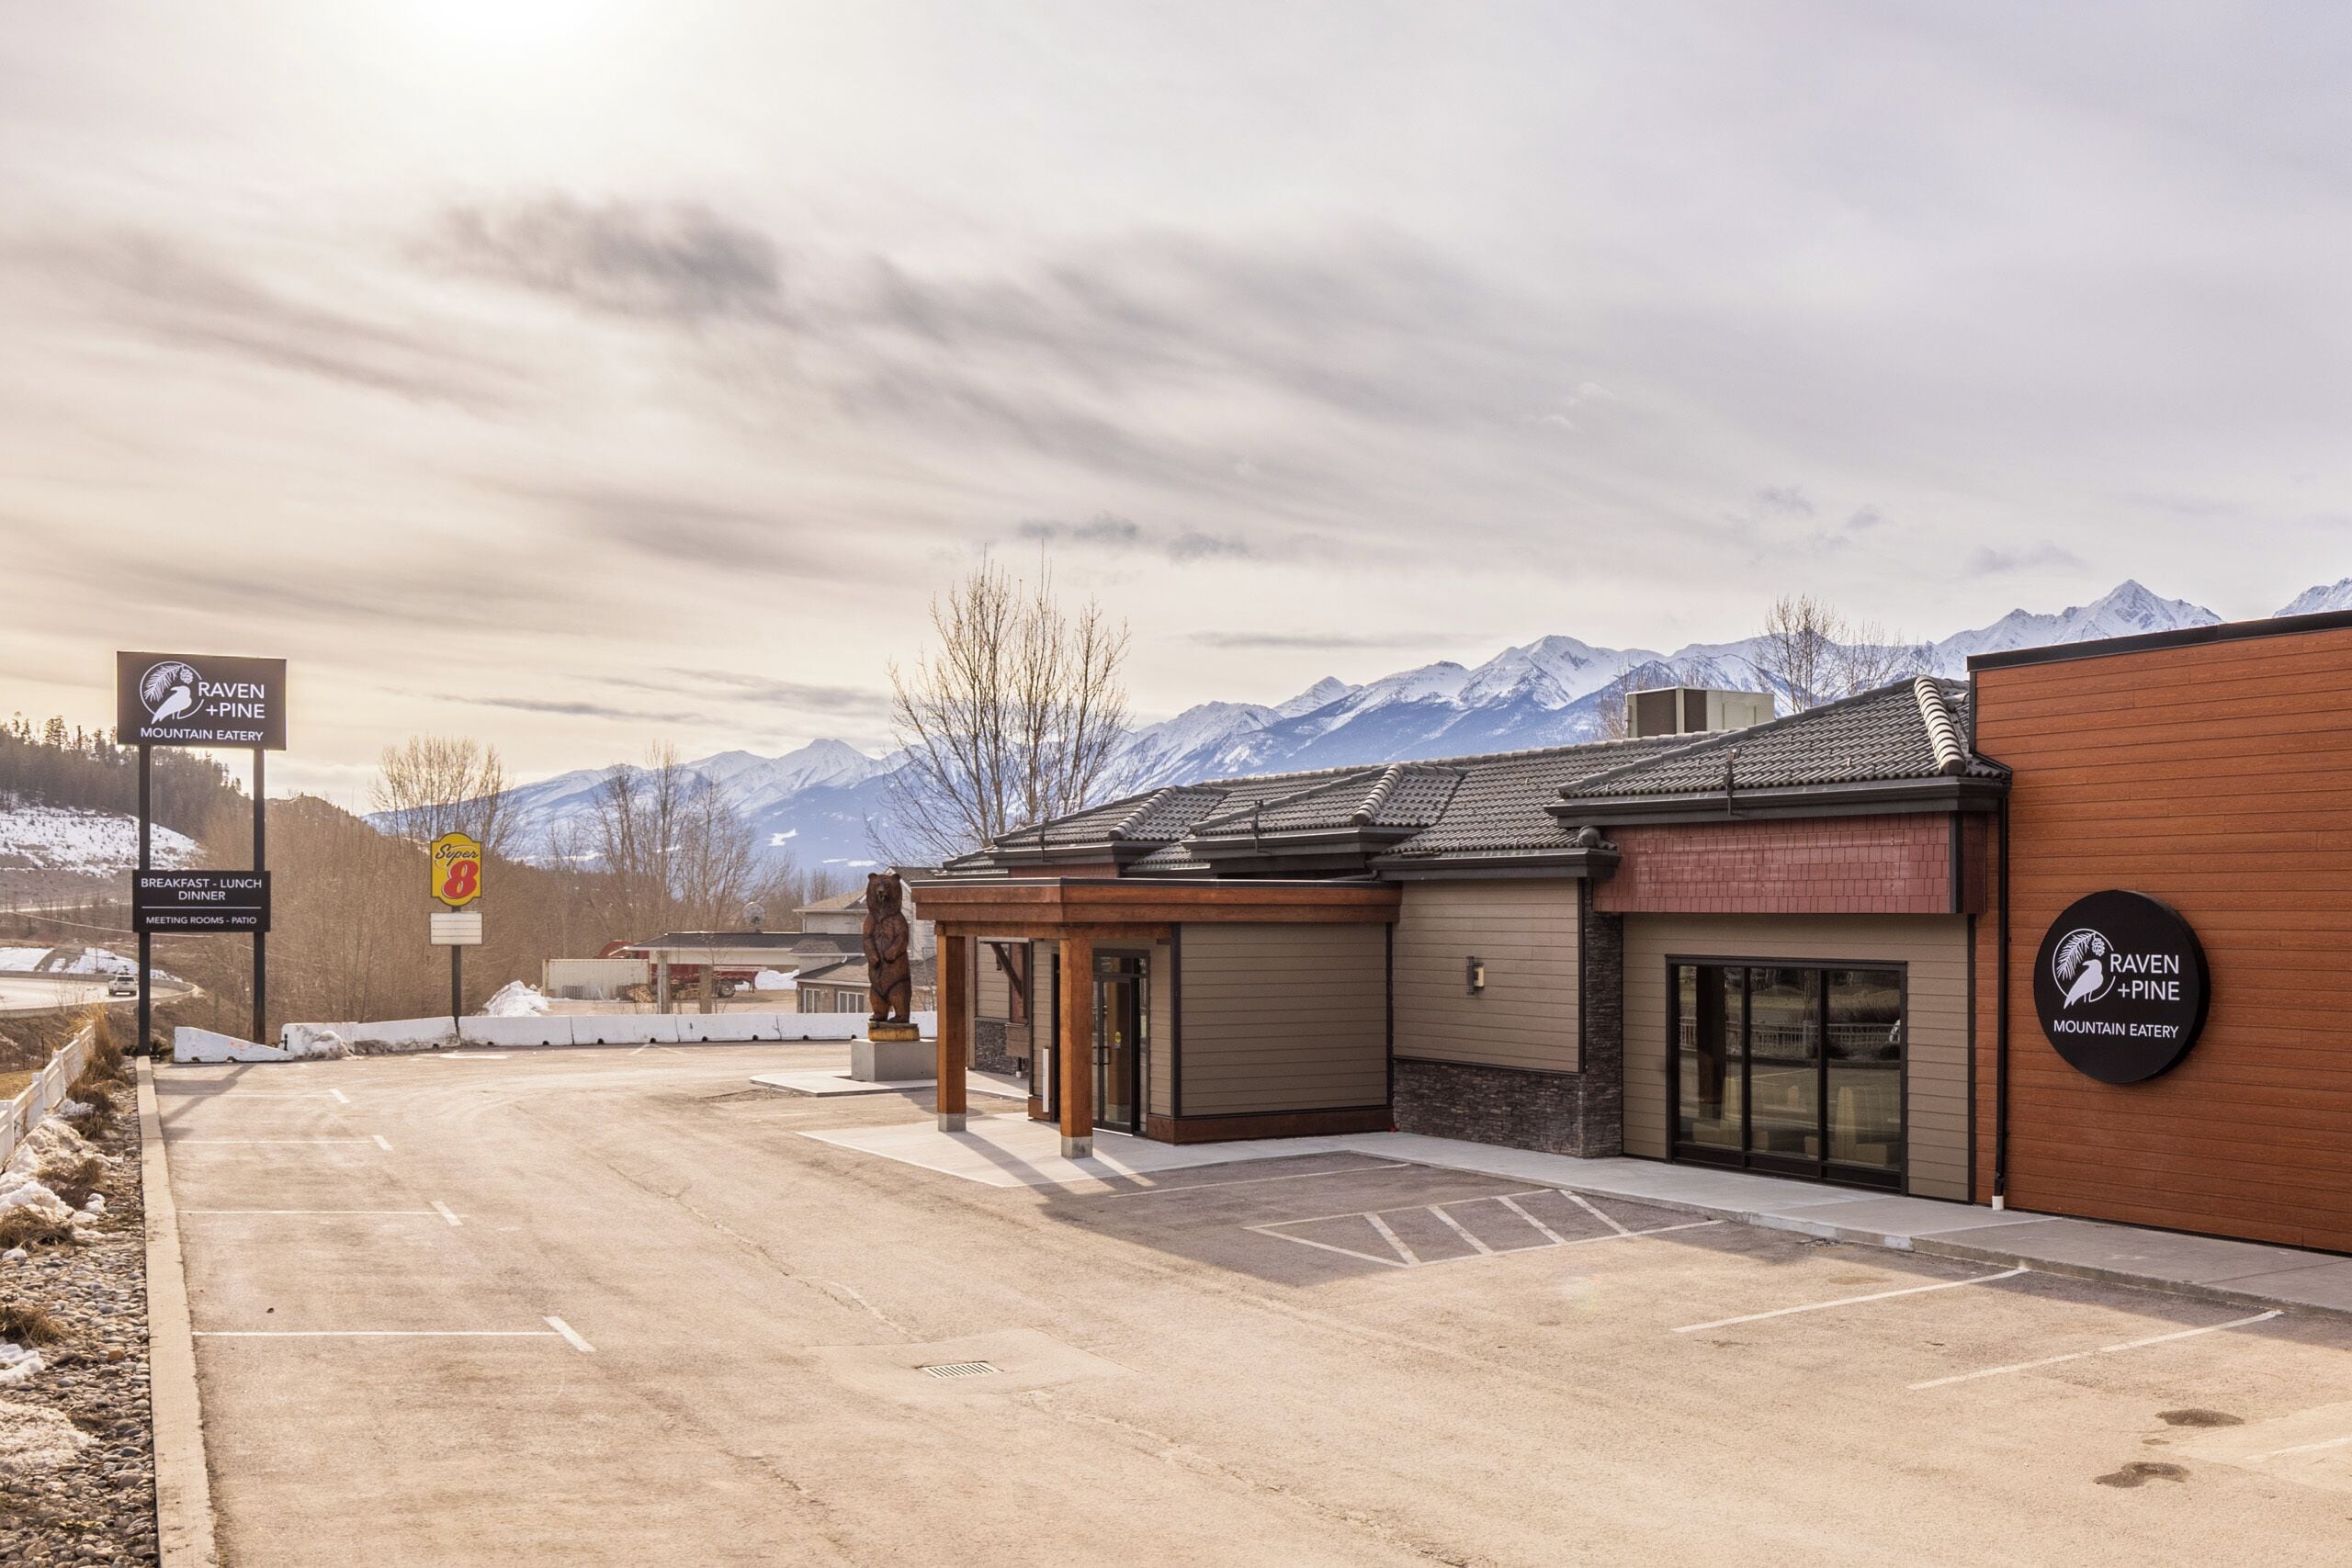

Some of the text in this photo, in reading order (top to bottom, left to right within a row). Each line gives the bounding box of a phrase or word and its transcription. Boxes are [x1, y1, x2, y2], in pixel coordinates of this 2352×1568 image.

[198, 682, 265, 699] RAVEN
[205, 702, 266, 718] +PINE
[141, 727, 264, 741] MOUNTAIN EATERY
[435, 843, 479, 866] Super
[141, 878, 209, 888] BREAKFAST
[220, 879, 262, 888] LUNCH
[442, 860, 479, 899] 8
[178, 891, 226, 900] DINNER
[146, 916, 188, 924] MEETING
[189, 916, 224, 924] ROOMS
[232, 916, 257, 924] PATIO
[2109, 953, 2179, 975] RAVEN
[2117, 980, 2180, 1001] +PINE
[2053, 1020, 2179, 1039] MOUNTAIN EATERY
